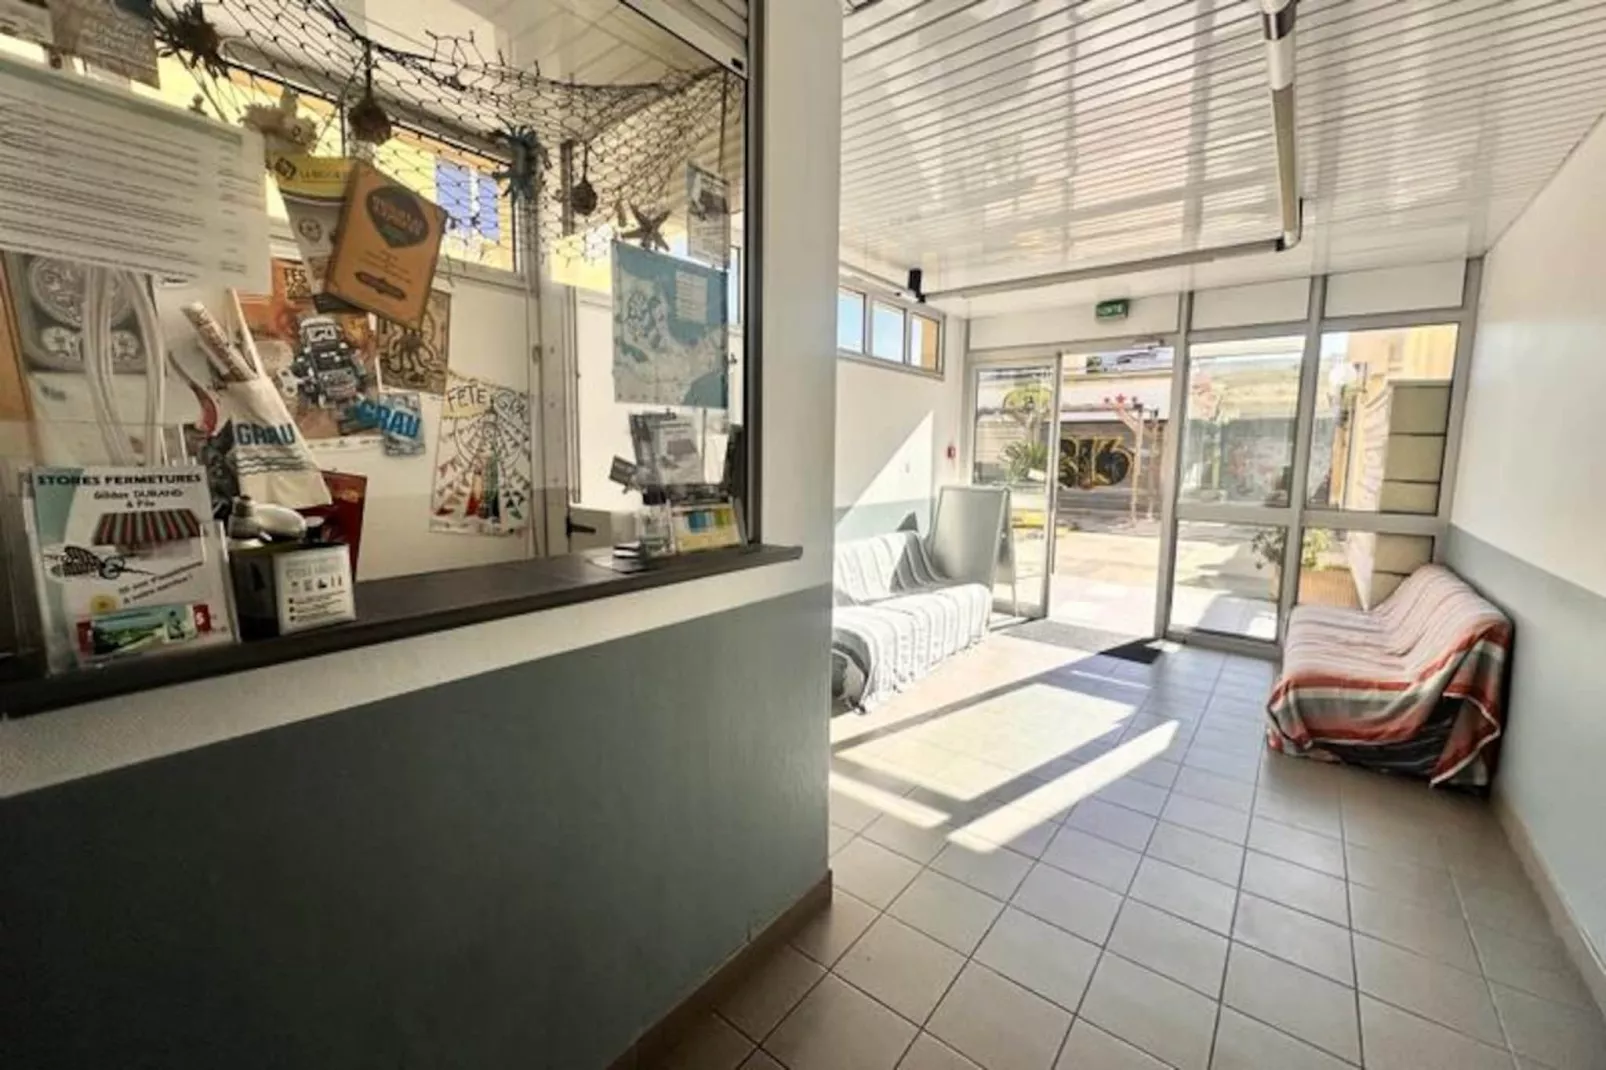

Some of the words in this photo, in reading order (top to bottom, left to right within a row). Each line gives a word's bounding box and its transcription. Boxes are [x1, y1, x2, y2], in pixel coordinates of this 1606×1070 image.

[356, 400, 421, 438] GRAU
[236, 423, 296, 446] GRAU
[38, 474, 100, 486] STORES
[105, 473, 201, 486] FERMETURES
[133, 488, 185, 499] DURAND
